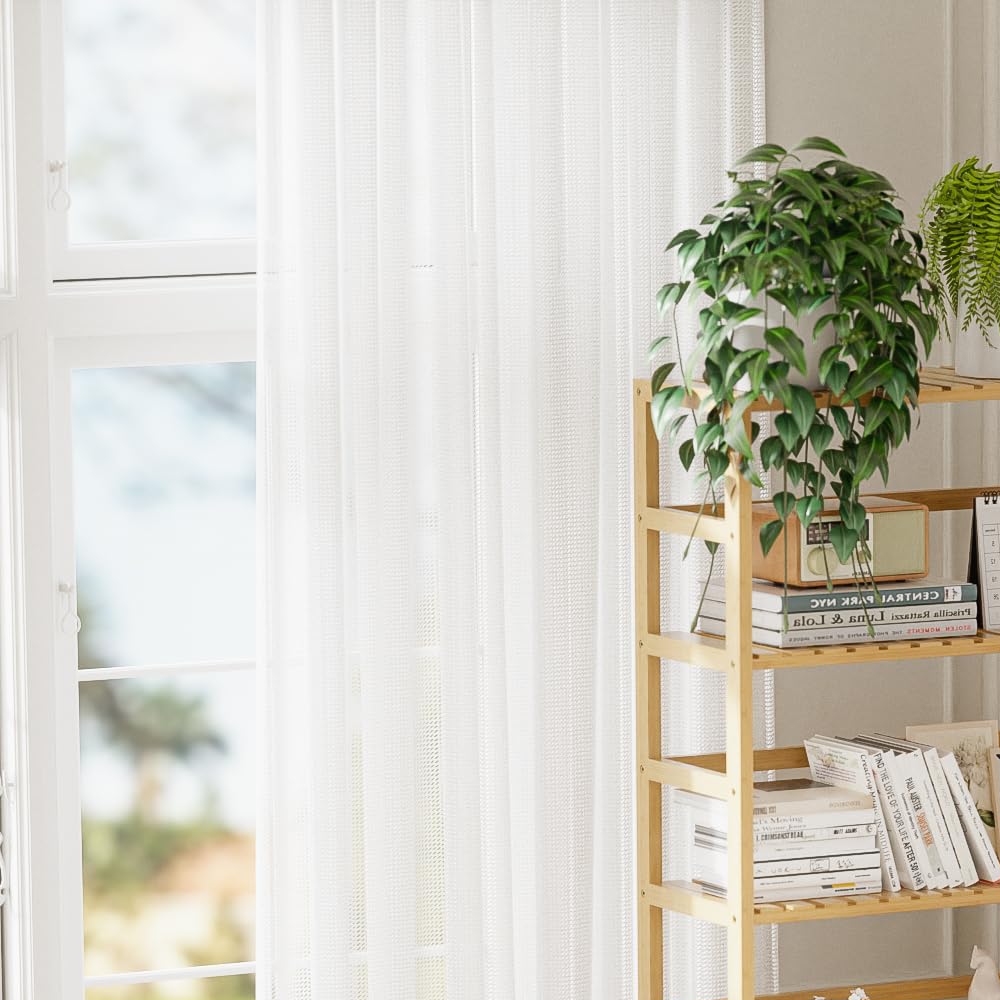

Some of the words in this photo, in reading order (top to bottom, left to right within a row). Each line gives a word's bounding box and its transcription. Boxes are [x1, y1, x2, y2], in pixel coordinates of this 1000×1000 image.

[874, 753, 884, 769] FIND
[860, 754, 872, 791] Creating
[880, 769, 889, 781] THE
[883, 782, 895, 799] LOVE
[904, 778, 914, 792] PAUL
[910, 792, 922, 811] AUSTER
[889, 799, 897, 810] OF
[893, 809, 904, 828] YOUR
[899, 828, 908, 842] LIFE
[902, 842, 915, 862] AFTER
